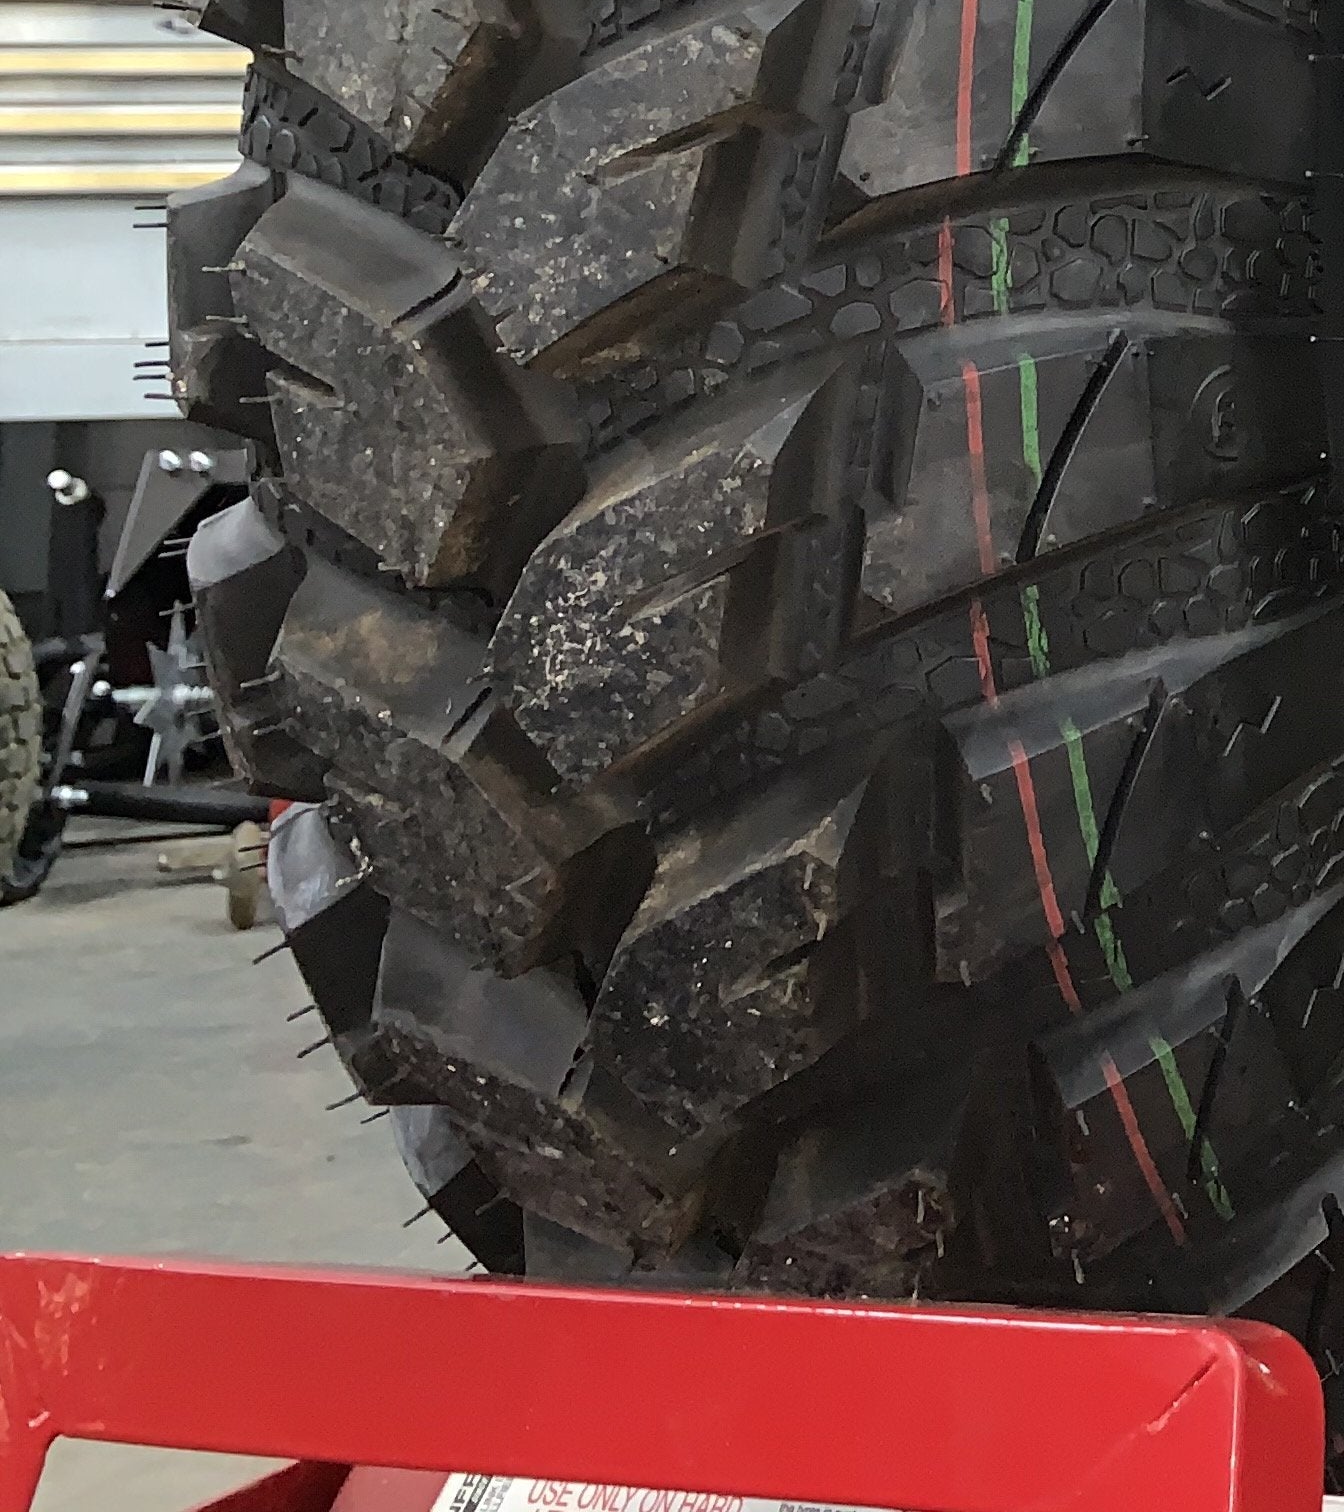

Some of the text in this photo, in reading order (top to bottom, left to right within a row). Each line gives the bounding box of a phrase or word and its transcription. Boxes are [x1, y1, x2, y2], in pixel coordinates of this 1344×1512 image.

[527, 1478, 573, 1507] USE
[577, 1482, 637, 1512] ONLY
[639, 1488, 677, 1512] ON
[678, 1492, 744, 1512] HARD
